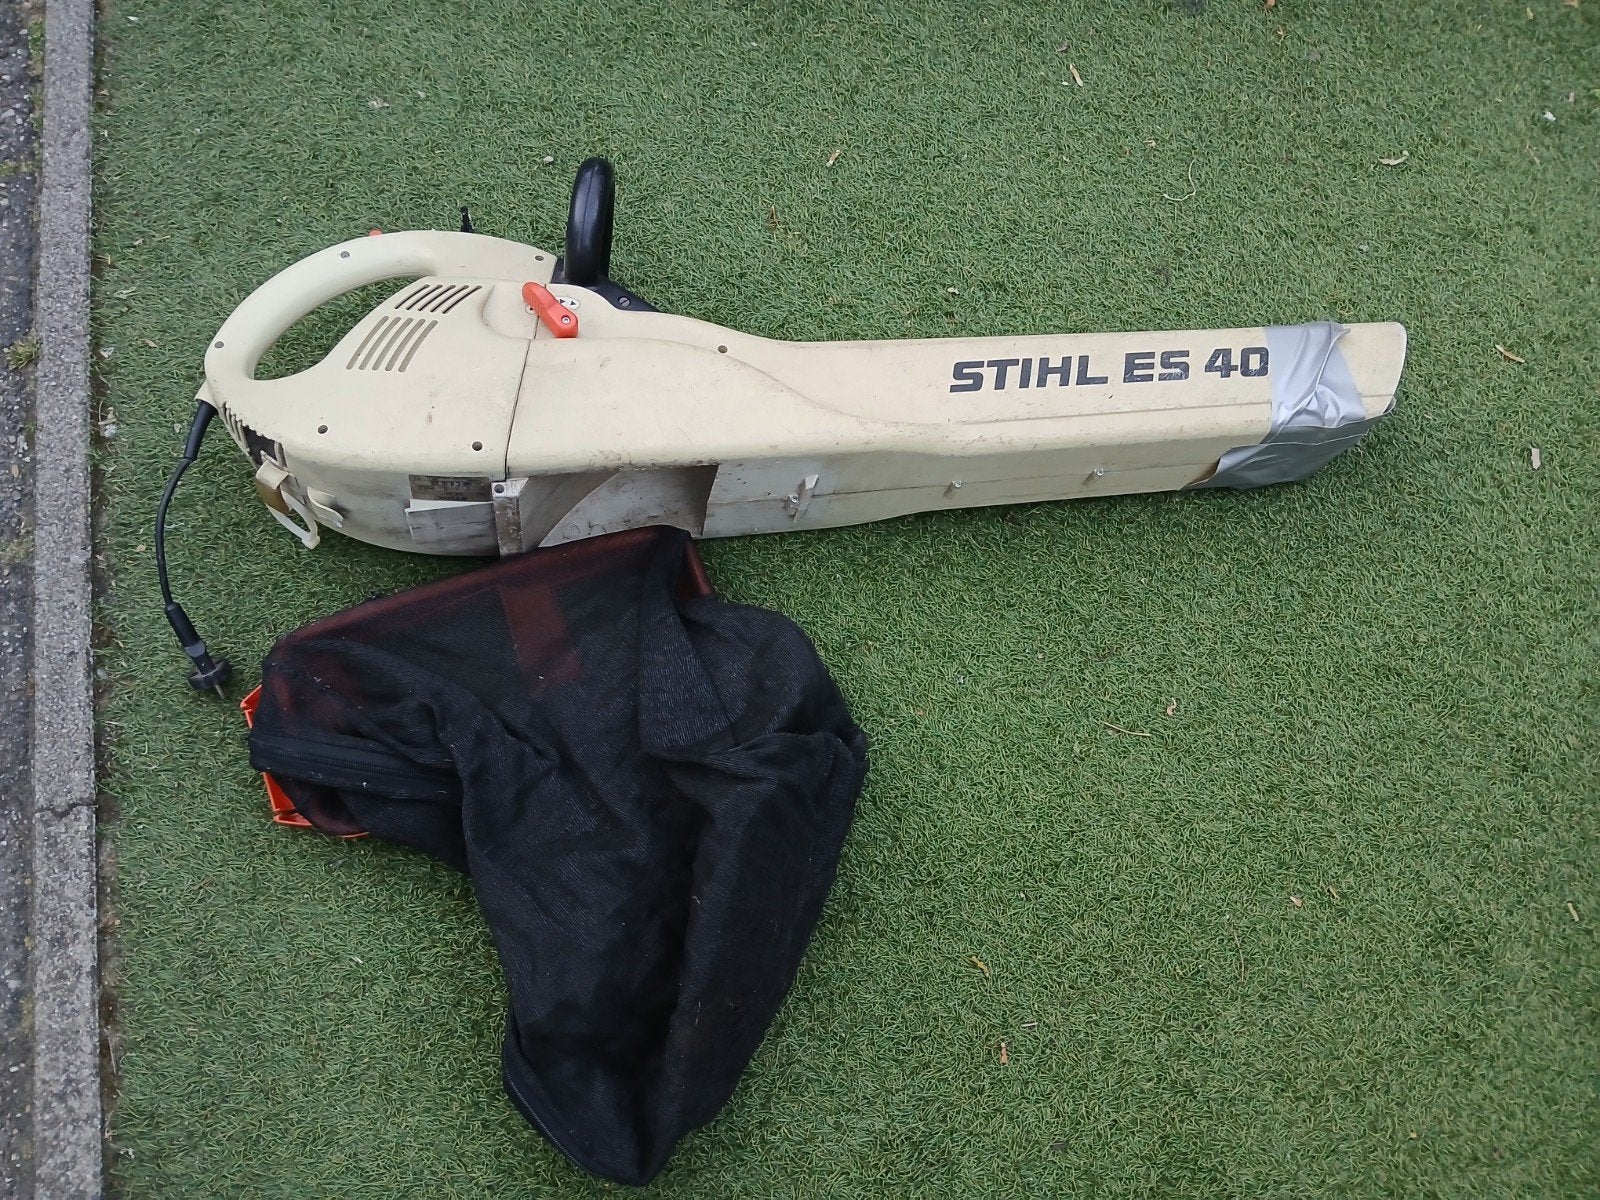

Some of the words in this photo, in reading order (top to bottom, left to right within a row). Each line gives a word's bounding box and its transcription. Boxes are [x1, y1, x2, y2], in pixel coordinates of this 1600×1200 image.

[949, 355, 1108, 393] STIHL
[1123, 350, 1190, 383] ES
[1204, 346, 1269, 379] 40
